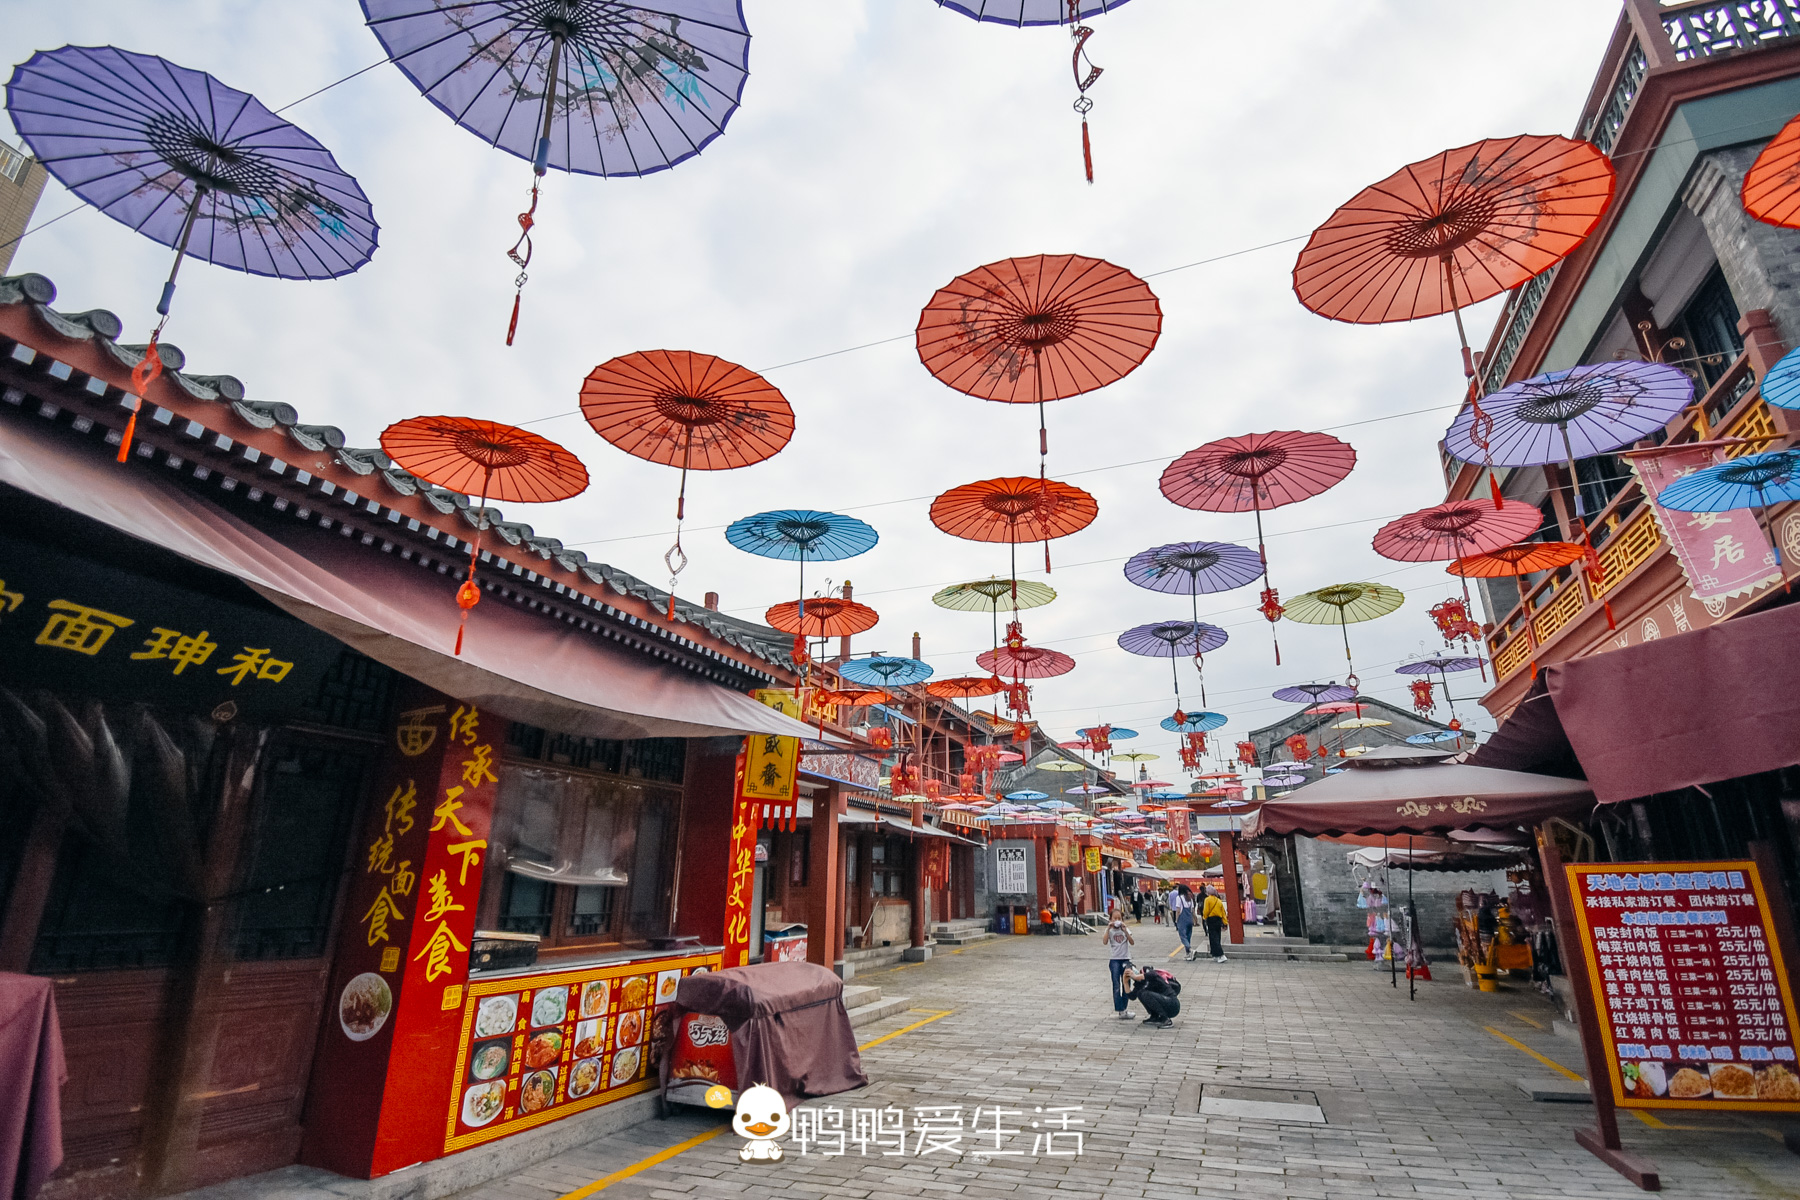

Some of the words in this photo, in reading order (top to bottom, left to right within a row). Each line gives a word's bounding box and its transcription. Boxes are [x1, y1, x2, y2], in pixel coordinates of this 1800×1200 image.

[414, 704, 499, 983] 传承天下美食
[361, 779, 418, 947] 传统面食
[727, 817, 753, 945] 中华文化
[1587, 872, 1745, 891] 天地会饭堂经营项目
[1586, 895, 1754, 908] 承接私家游订餐、团体游订餐
[1621, 911, 1728, 925] 本店供应套餐系列
[1594, 927, 1659, 939] 同安封肉饭
[1715, 926, 1762, 938] 25元/份
[1597, 941, 1662, 953] 梅菜扣肉饭
[1719, 940, 1766, 953] 25元/份
[1600, 955, 1665, 967] 笋干烧肉饭
[1722, 954, 1769, 967] 25元/份
[1603, 969, 1669, 982] 鱼香肉丝饭
[1726, 969, 1773, 981] 25元/份
[1606, 983, 1672, 996] 姜母鸭饭
[1729, 983, 1777, 996] 25元/份
[567, 984, 579, 1021] 水饺
[1609, 998, 1675, 1010] 辣子鸡丁饭
[1733, 998, 1780, 1011] 25元/份
[1612, 1012, 1678, 1025] 红烧排骨饭
[1736, 1013, 1784, 1026] 25元/份
[1615, 1027, 1681, 1039] 红烧肉饭
[1739, 1027, 1787, 1040] 25元/份
[561, 1024, 574, 1062] 牛肉面
